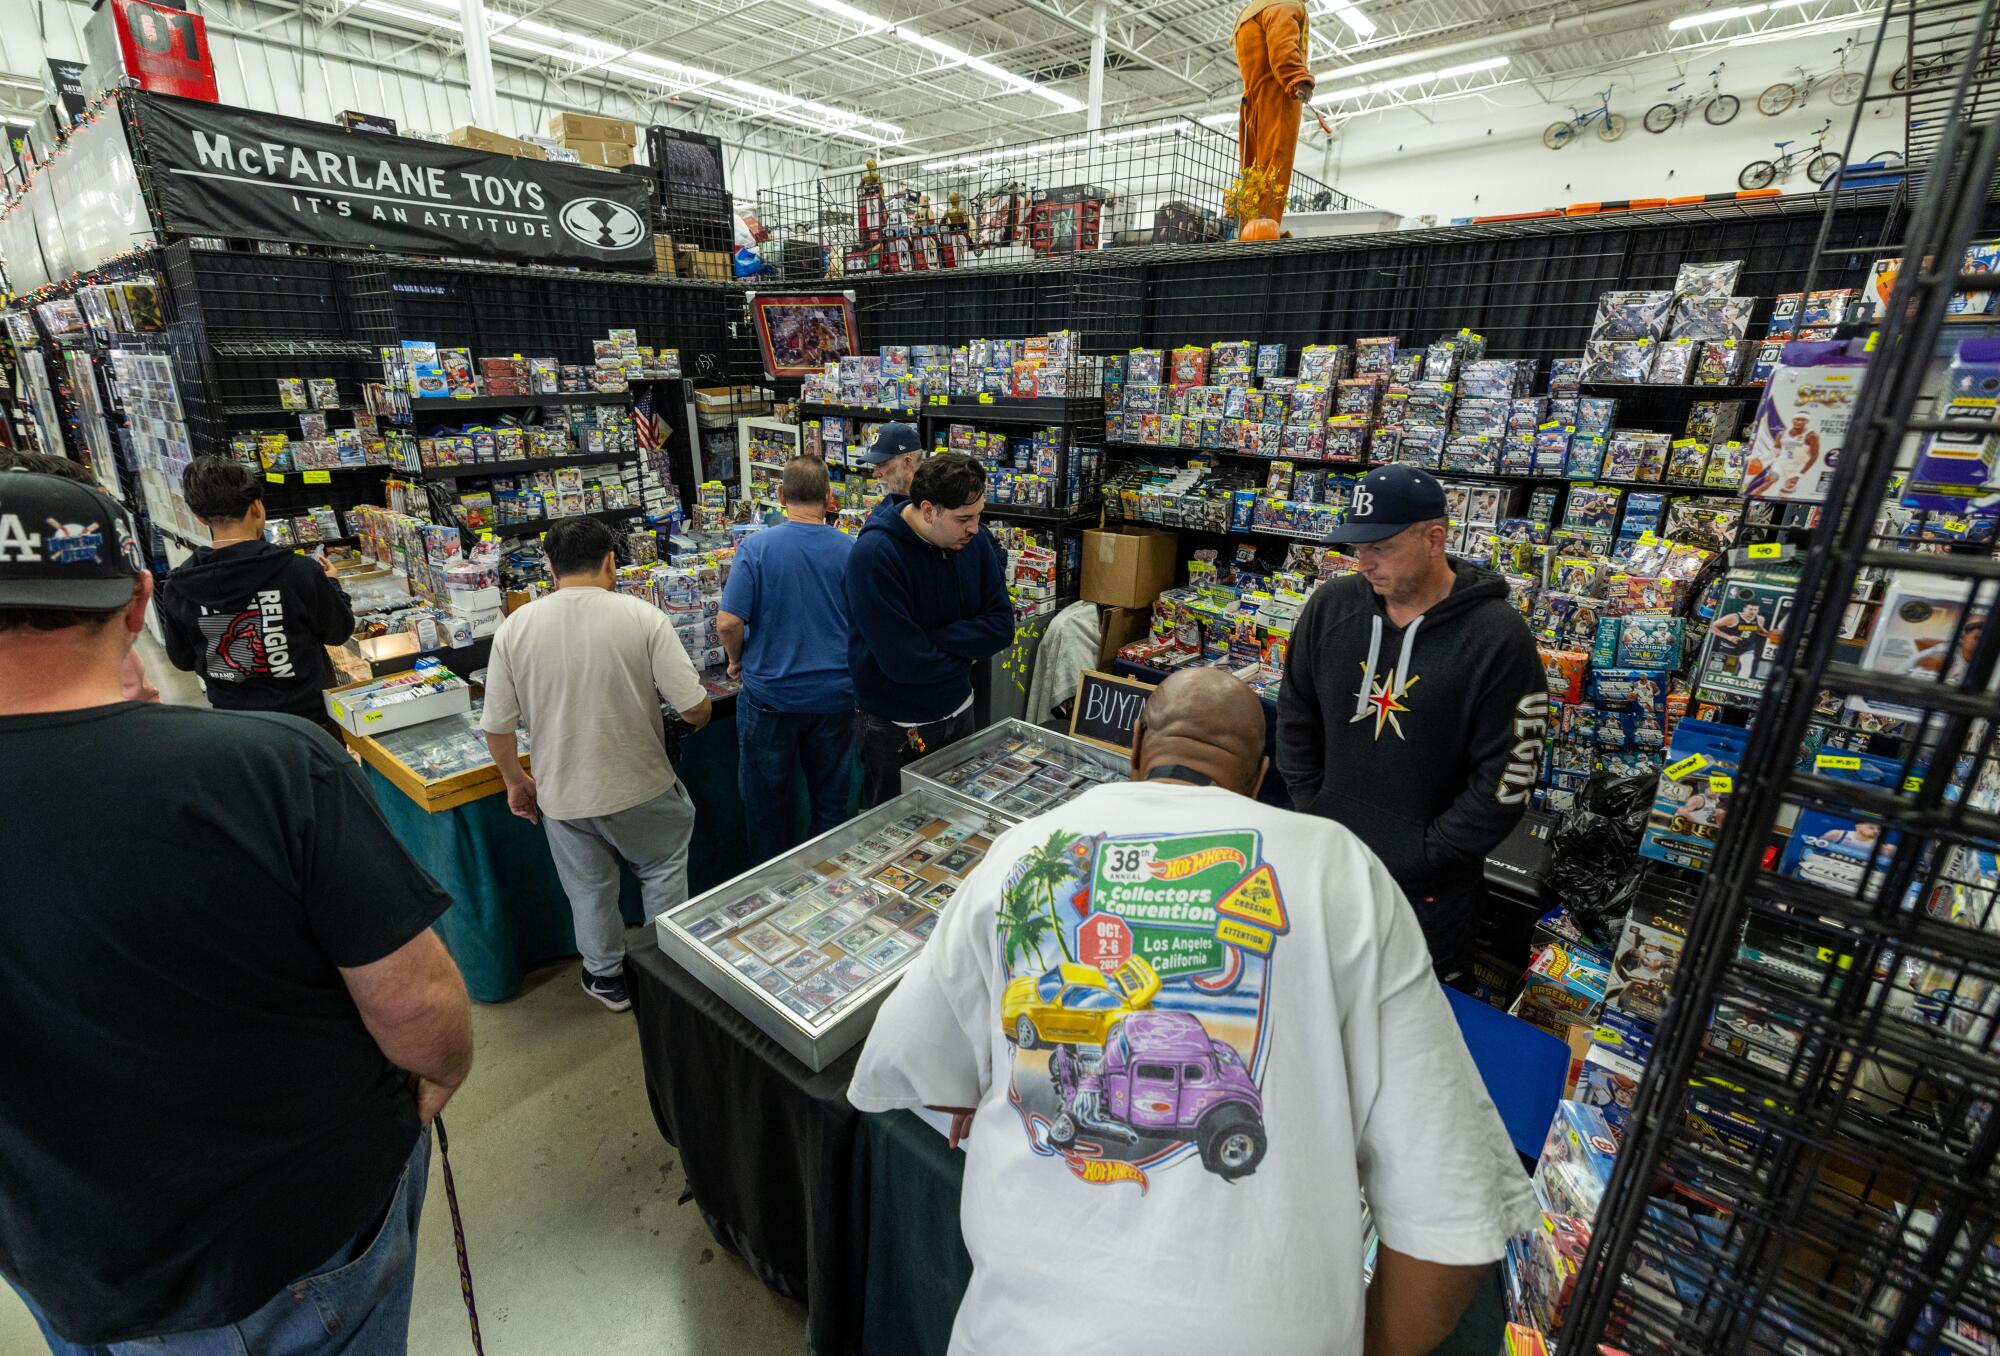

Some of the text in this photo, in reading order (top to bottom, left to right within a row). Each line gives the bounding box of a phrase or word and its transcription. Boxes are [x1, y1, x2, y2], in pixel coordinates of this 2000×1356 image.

[192, 130, 546, 211] McFARLANE TOYS
[292, 195, 552, 238] IT'S AN ATTITUDE
[1351, 484, 1374, 516] TB
[257, 590, 297, 678] RELIGION
[209, 671, 235, 679] BRAND
[1805, 836, 1829, 848] 20
[1110, 873, 1142, 881] ANNUAL
[1111, 886, 1213, 903] Collectors
[1106, 900, 1218, 921] Convention
[1234, 898, 1272, 916] CROSSING
[1097, 921, 1123, 939] OCT.
[1223, 926, 1265, 945] ATTENTION
[1099, 939, 1119, 955] 2-6
[1143, 936, 1213, 952] Los Angeles
[1151, 953, 1208, 971] California
[1532, 985, 1585, 1010] BASEBALL
